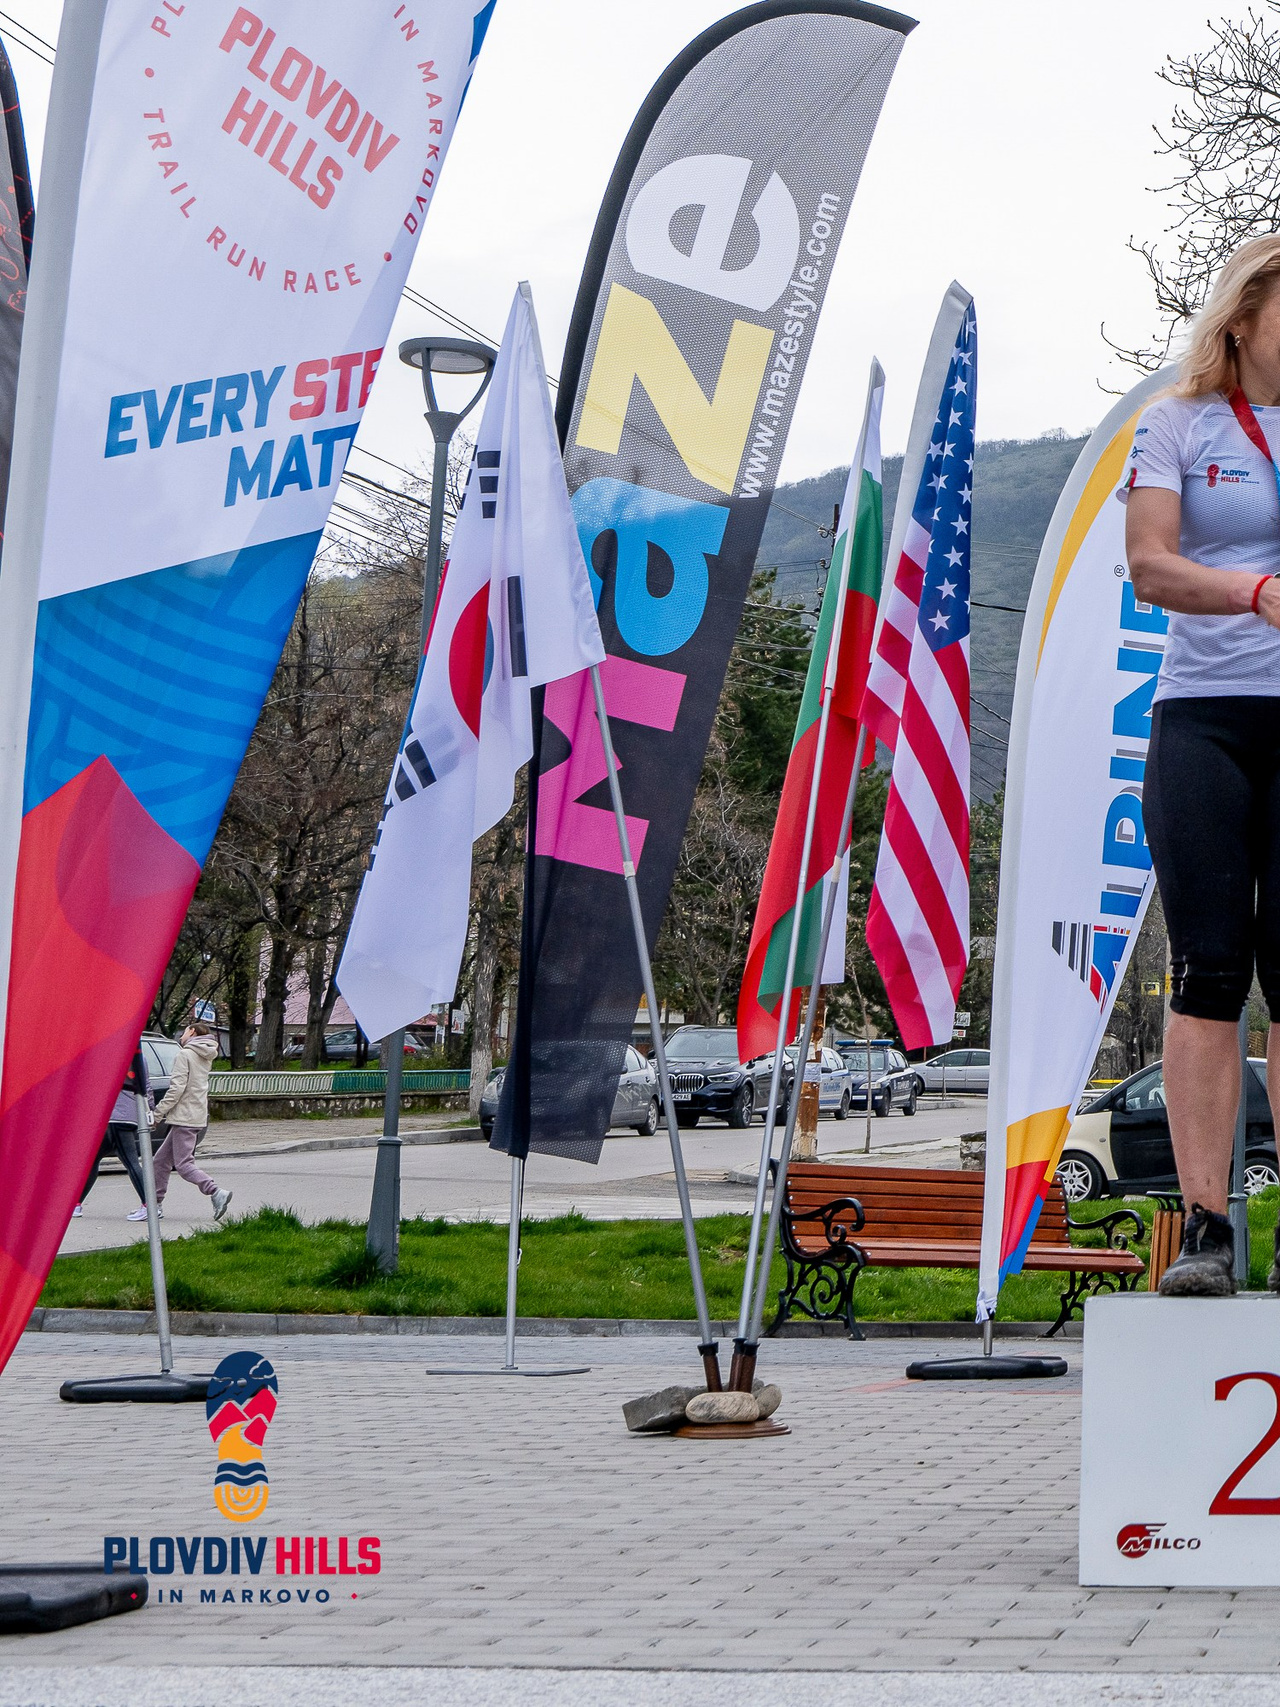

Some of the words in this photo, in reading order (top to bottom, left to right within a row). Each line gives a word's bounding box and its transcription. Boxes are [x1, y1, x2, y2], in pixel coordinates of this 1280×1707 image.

[218, 6, 400, 173] PLOVDIV
[394, 4, 419, 42] IN
[143, 108, 197, 219] TRAIL
[206, 225, 266, 281] RUN
[283, 263, 362, 294] RACE
[221, 86, 343, 210] HILLS
[404, 60, 443, 235] MARKOVO
[104, 365, 286, 458] EVERY
[738, 192, 841, 499] www.mazestyle.com
[1120, 1535, 1201, 1552] MILCO
